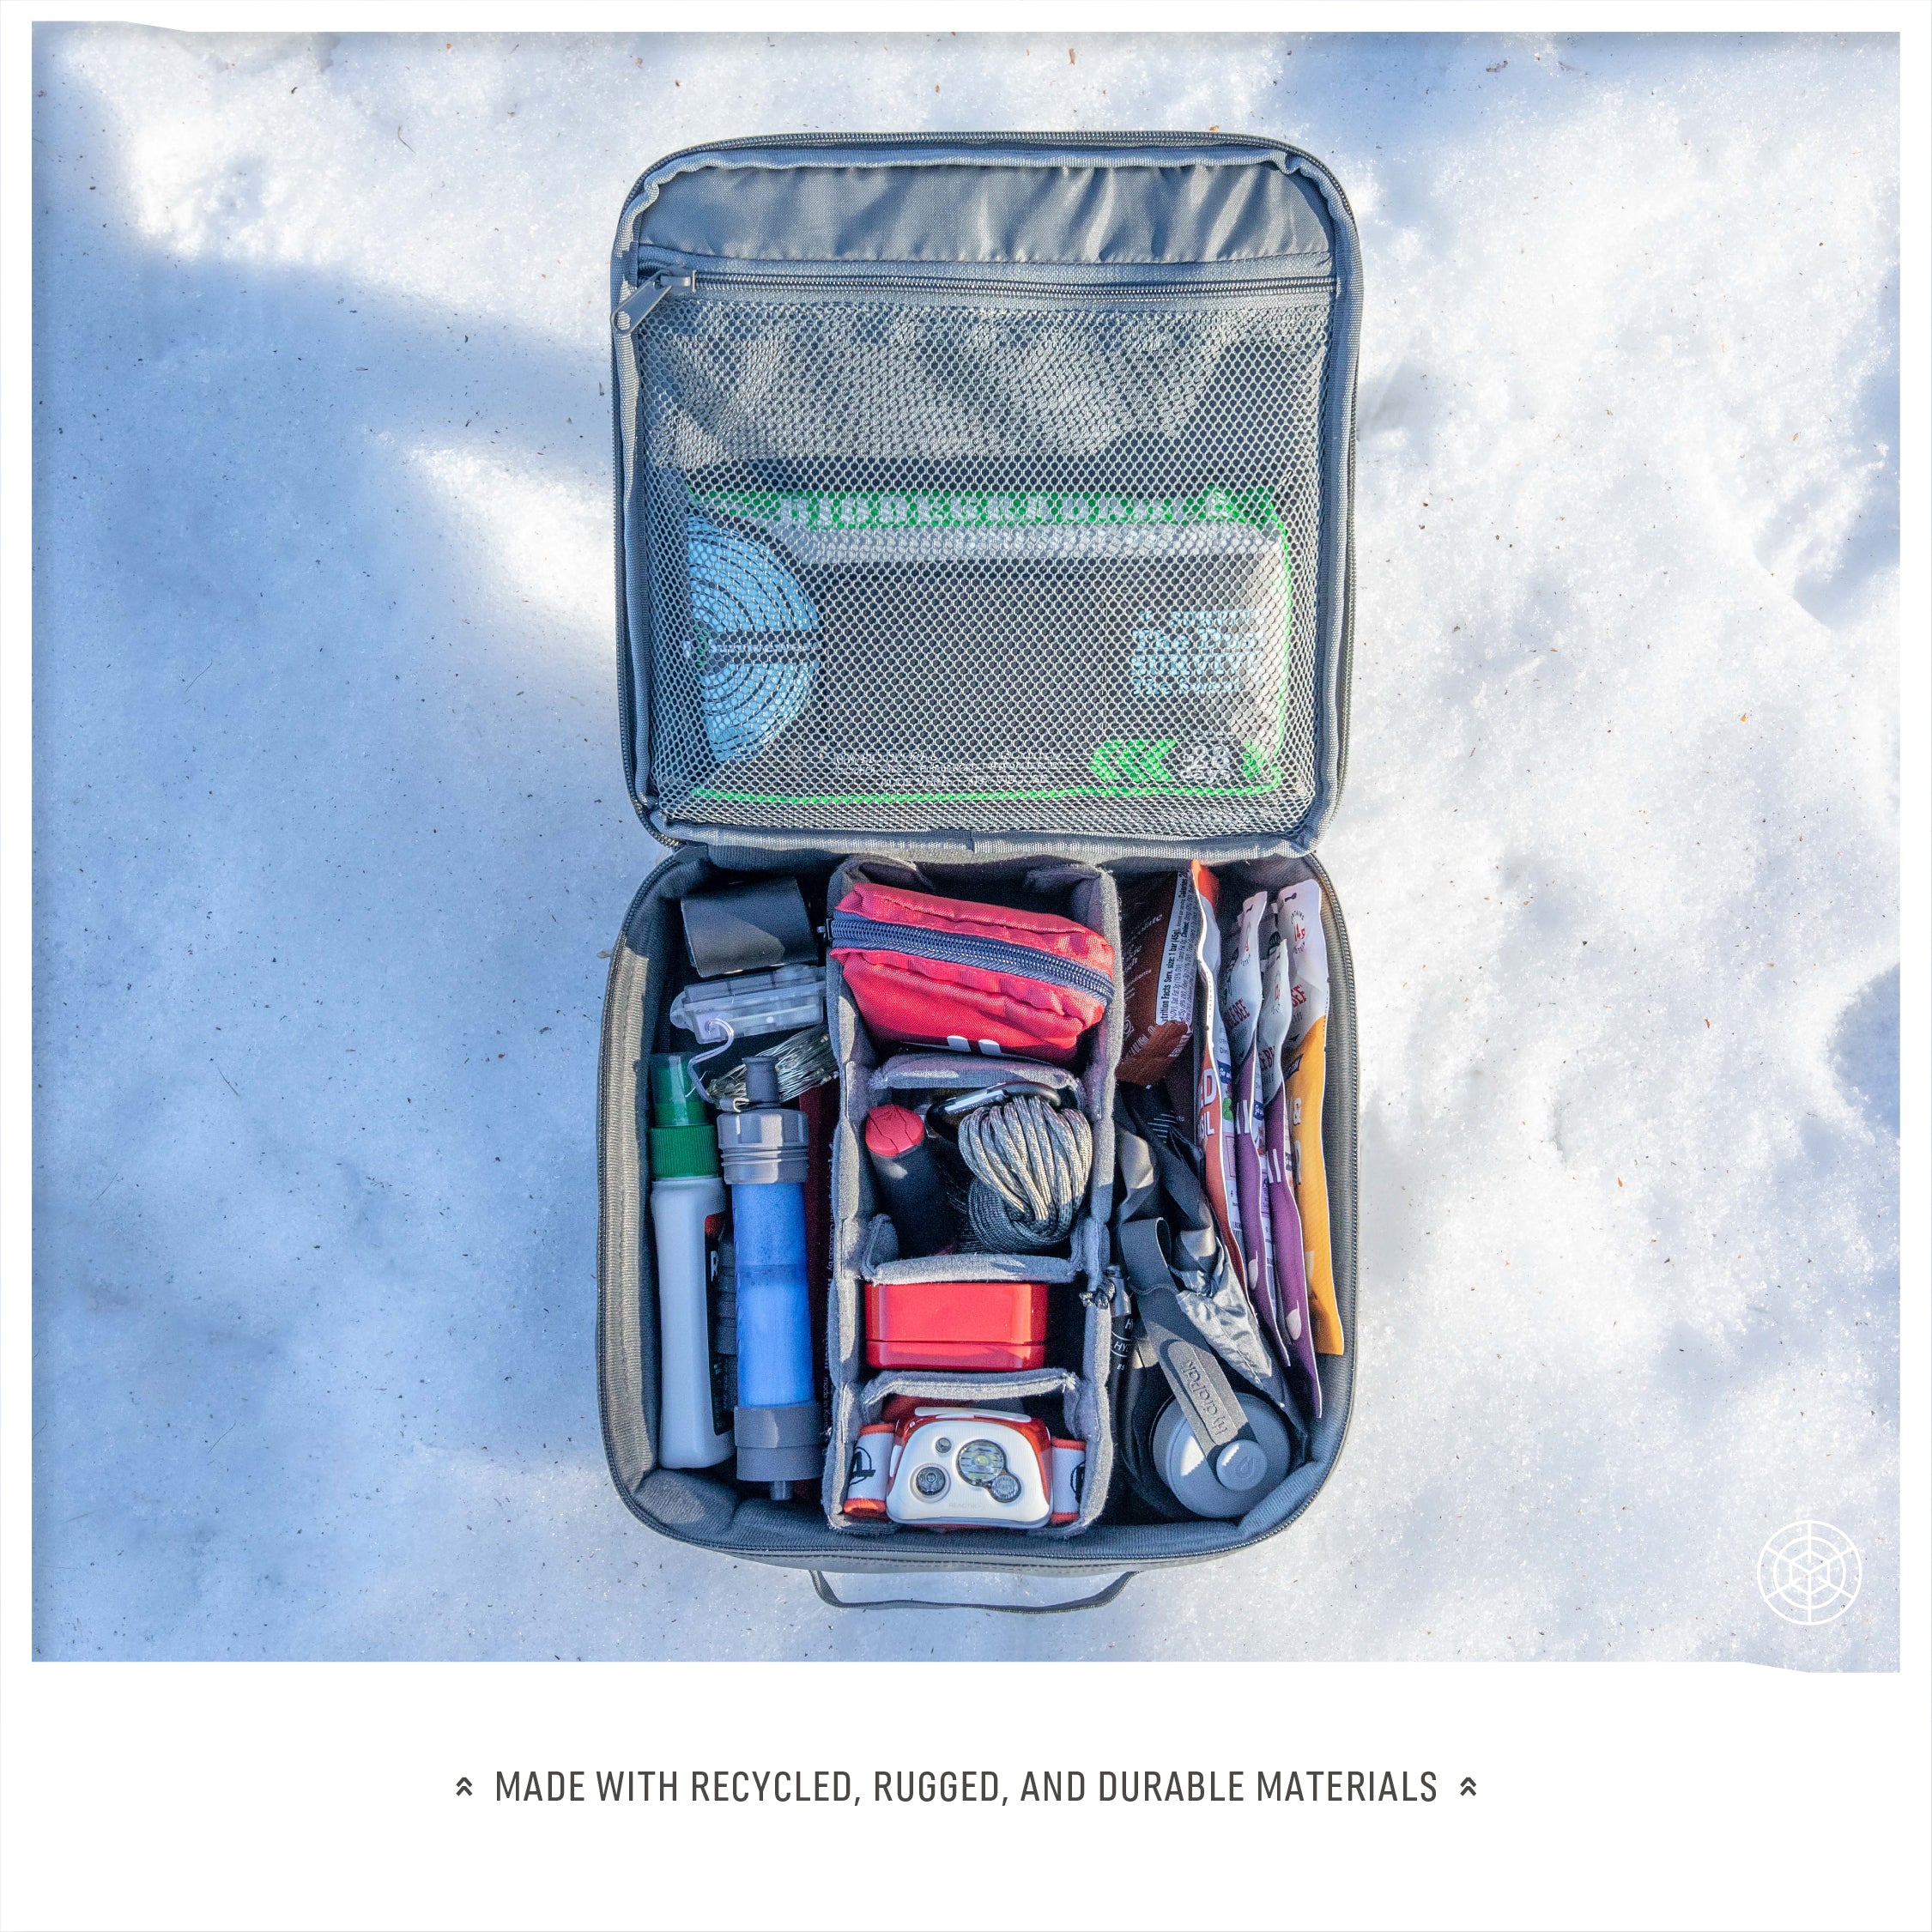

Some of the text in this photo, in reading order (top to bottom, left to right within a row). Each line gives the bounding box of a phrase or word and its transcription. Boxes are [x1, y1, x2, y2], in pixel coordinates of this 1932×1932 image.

[1168, 942, 1177, 953] bar
[1163, 968, 1172, 984] Serv.
[1160, 983, 1171, 1001] Facts
